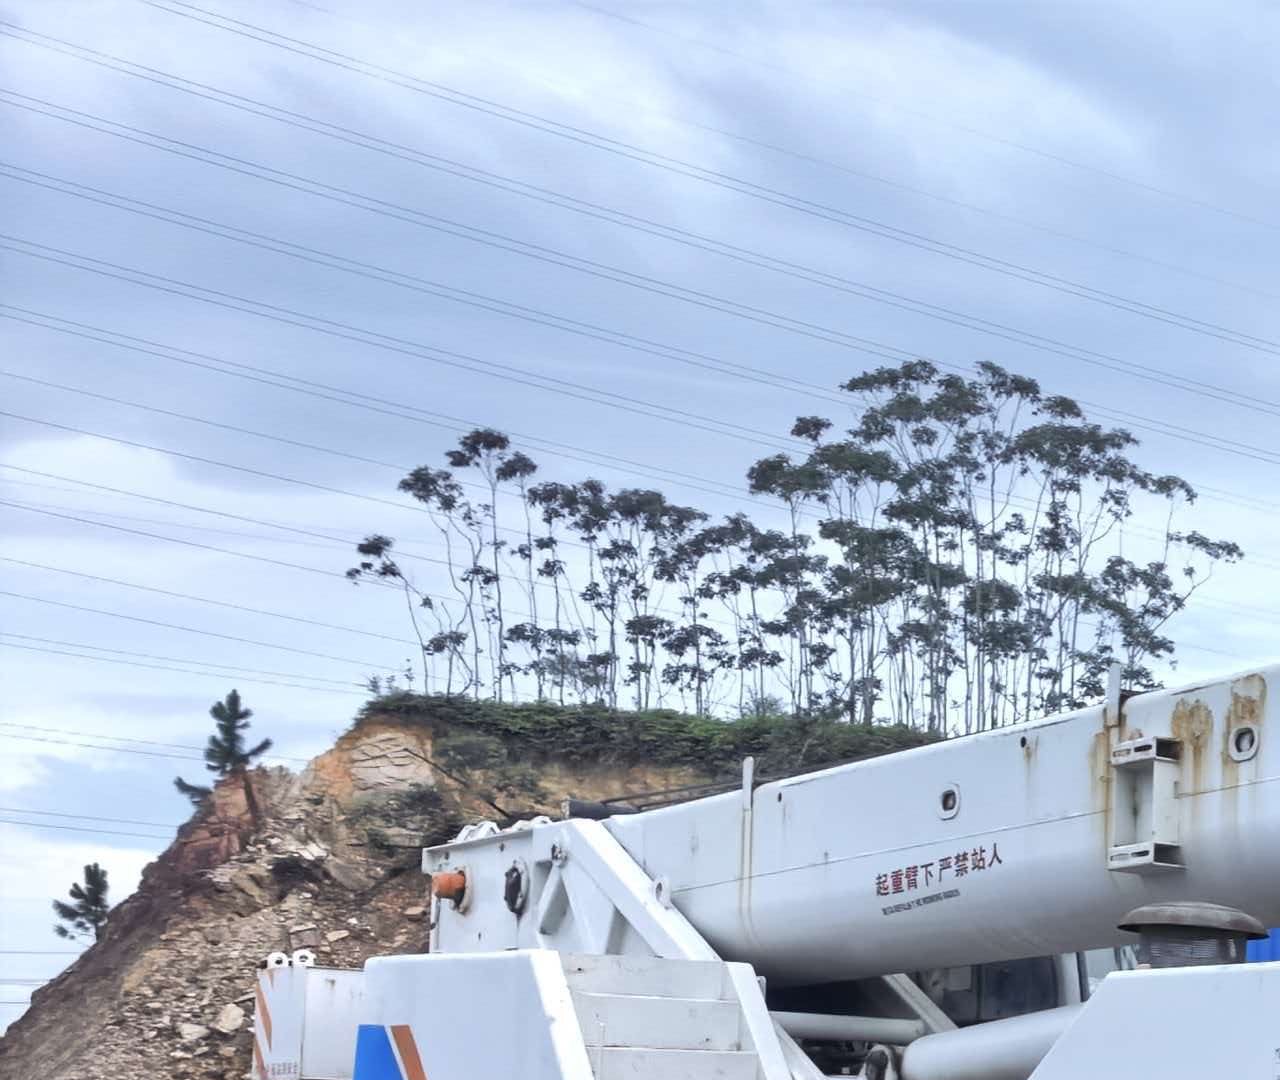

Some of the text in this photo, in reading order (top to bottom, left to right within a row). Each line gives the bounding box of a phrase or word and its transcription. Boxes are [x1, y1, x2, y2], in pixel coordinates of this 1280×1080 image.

[875, 842, 1003, 896] 起重臂下严禁站人
